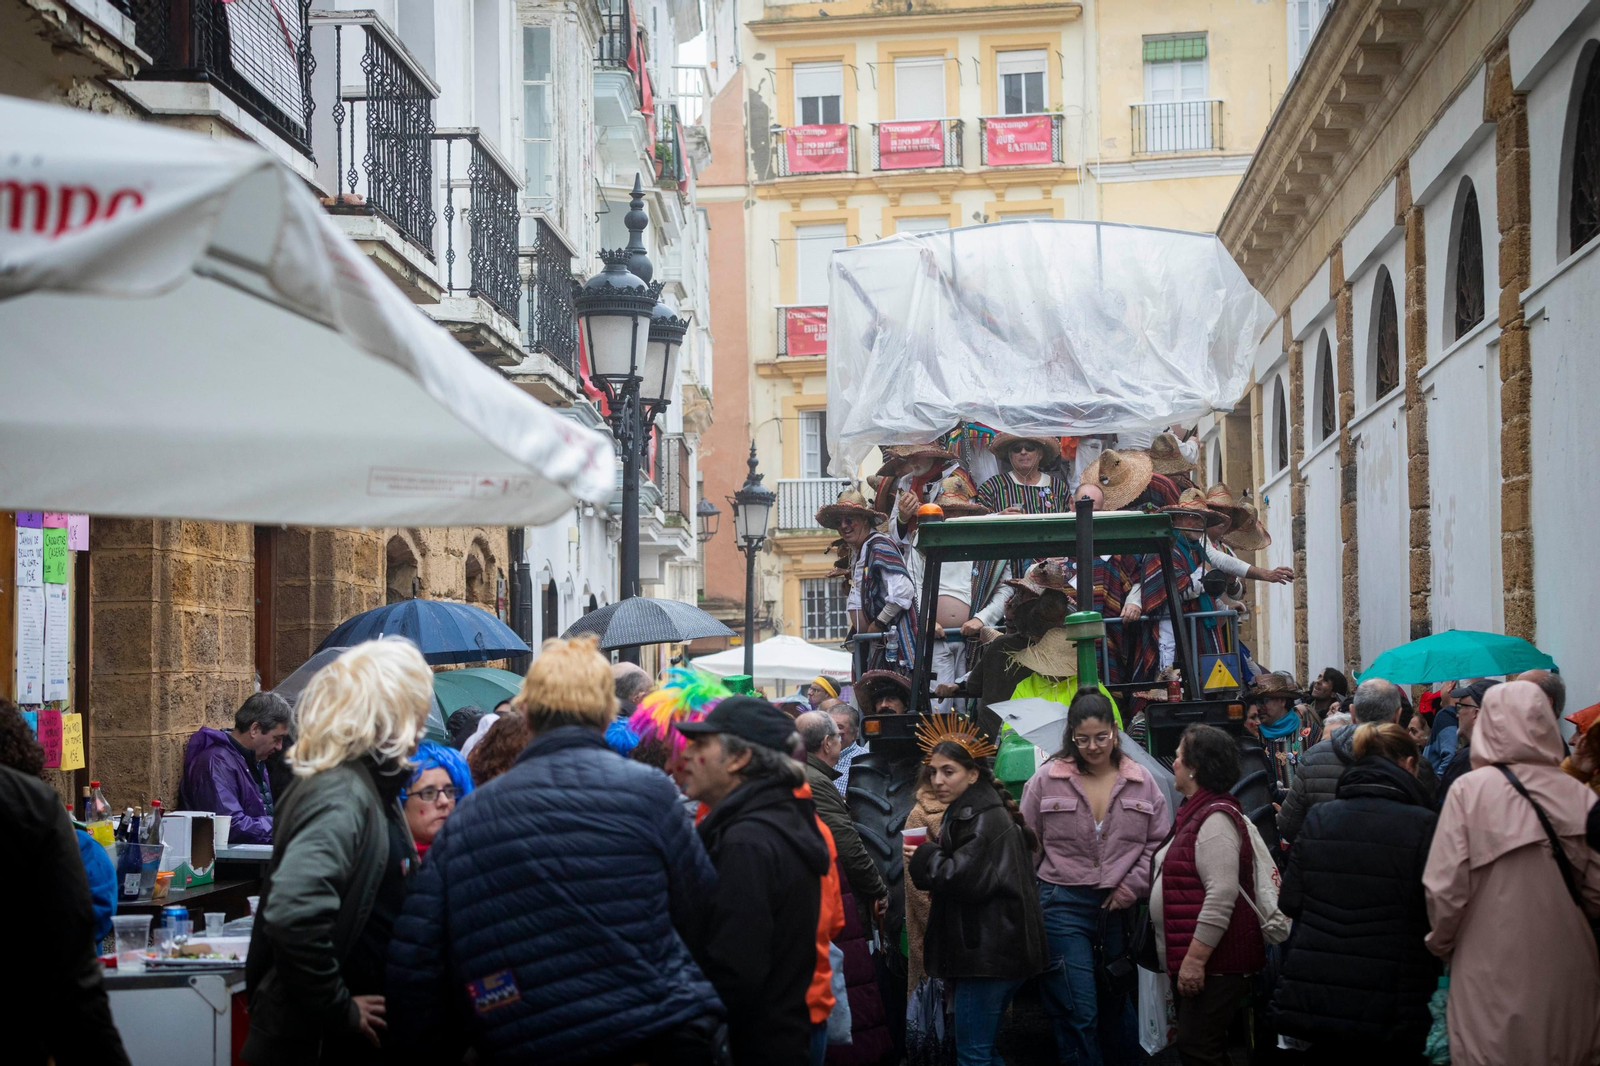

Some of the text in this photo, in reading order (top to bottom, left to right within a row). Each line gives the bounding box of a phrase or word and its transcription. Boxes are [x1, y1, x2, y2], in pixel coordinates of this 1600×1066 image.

[881, 124, 921, 133] Cruzcampo
[987, 120, 1028, 129] Cruzcampo
[787, 128, 827, 136] Cruzcampo
[804, 324, 818, 333] ESTO
[45, 533, 66, 547] CROQUETAS
[48, 547, 65, 560] CASERAS
[25, 569, 36, 583] 15€
